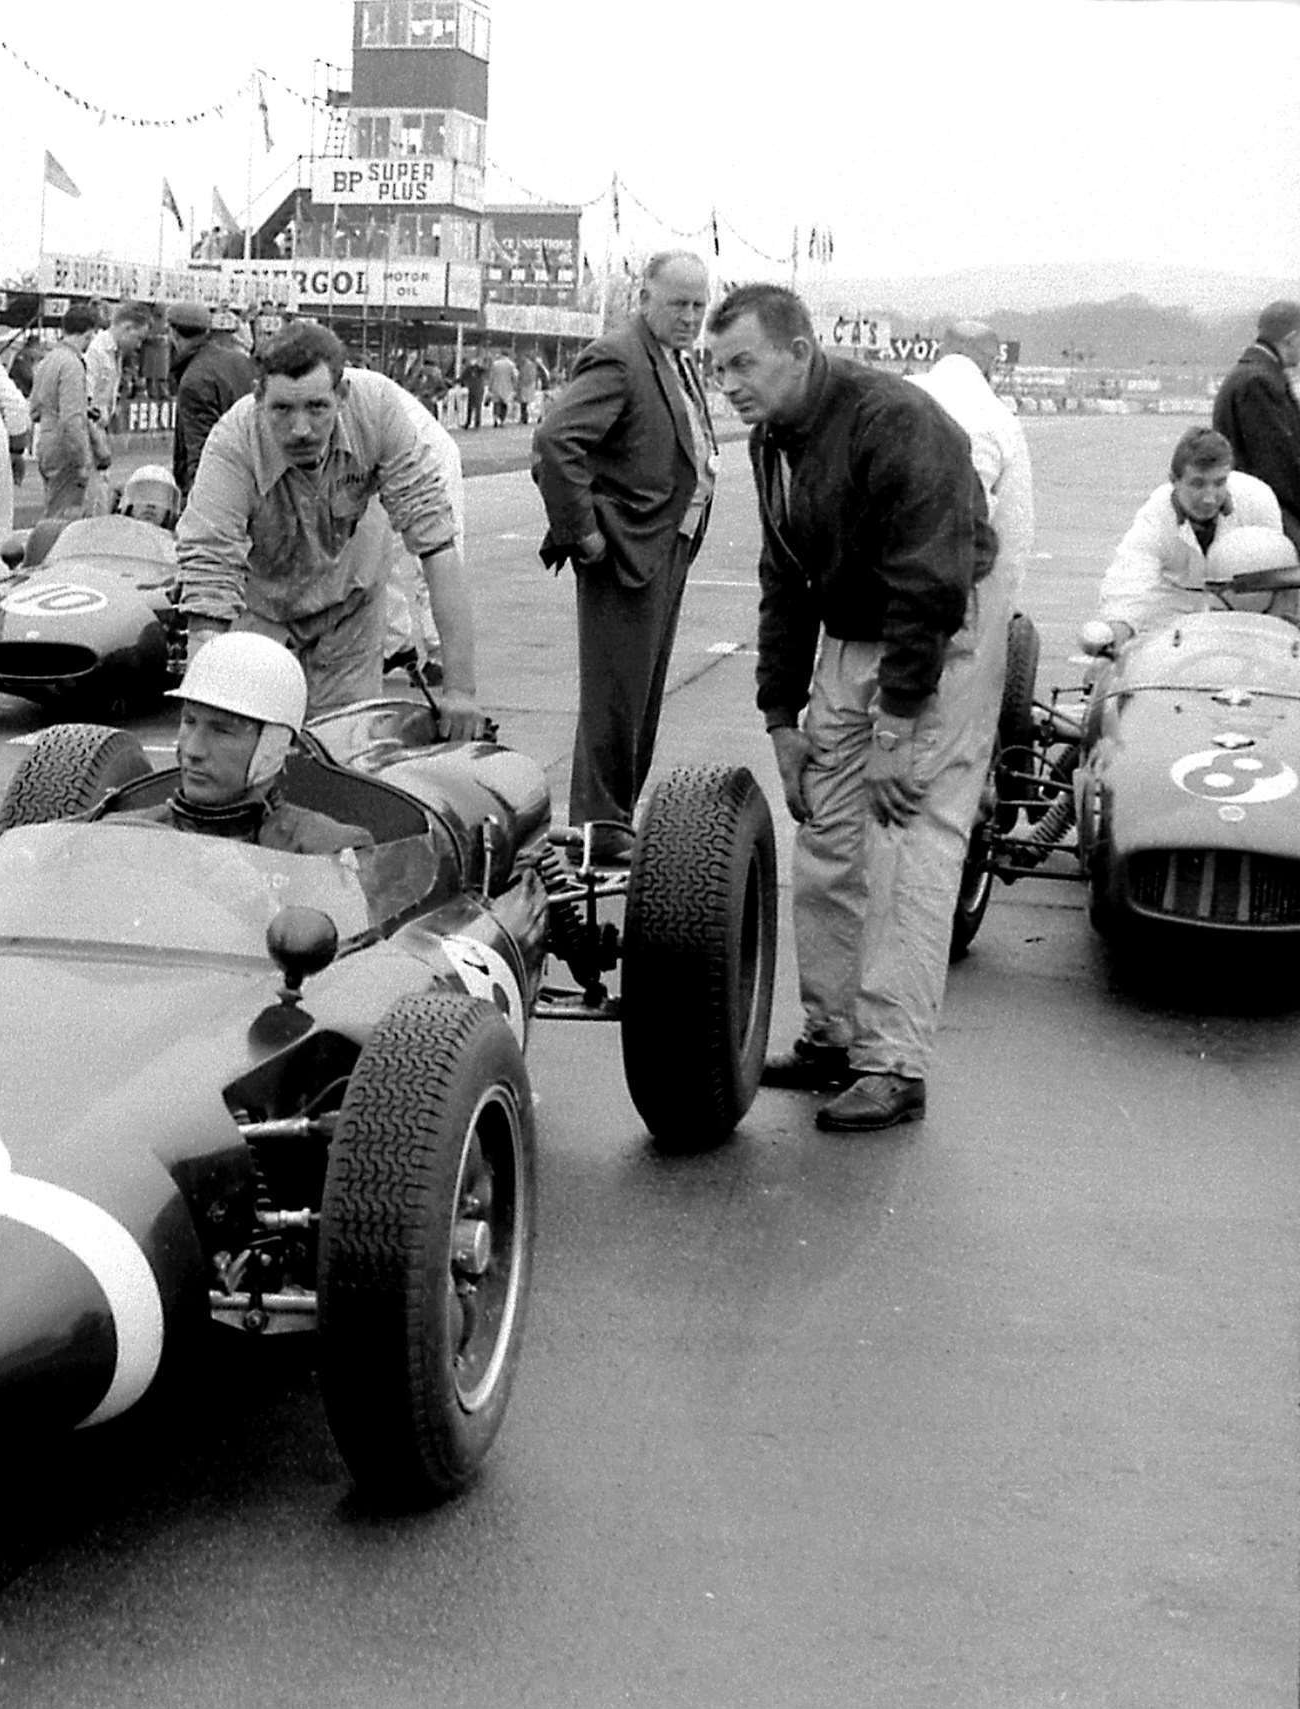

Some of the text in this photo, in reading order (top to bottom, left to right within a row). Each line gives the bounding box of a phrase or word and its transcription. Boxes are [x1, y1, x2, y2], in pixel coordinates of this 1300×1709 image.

[332, 171, 363, 193] BP
[368, 163, 435, 182] SUPER
[378, 183, 428, 201] PLUS
[233, 269, 370, 295] RGOL
[384, 271, 430, 283] MOTOR
[397, 286, 419, 297] OIL
[13, 585, 104, 611] 10
[1183, 751, 1285, 798] 8
